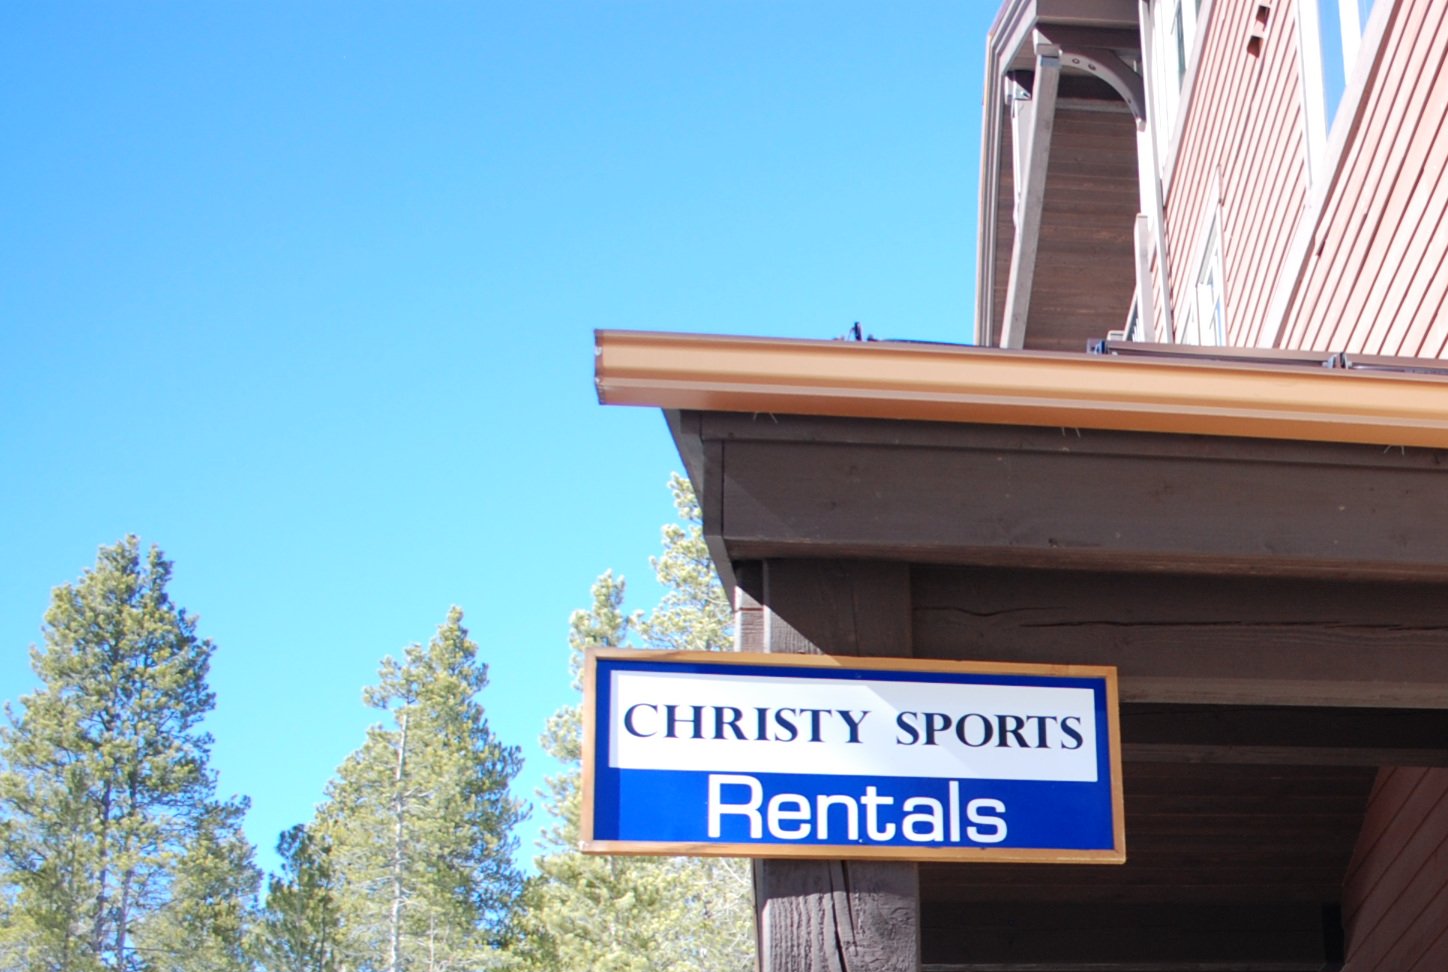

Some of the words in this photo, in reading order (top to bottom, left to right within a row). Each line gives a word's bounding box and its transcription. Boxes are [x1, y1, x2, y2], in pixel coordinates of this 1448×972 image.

[623, 702, 872, 744] CHRISTY
[896, 710, 1084, 750] SPORTS
[707, 773, 1008, 844] Rentals
